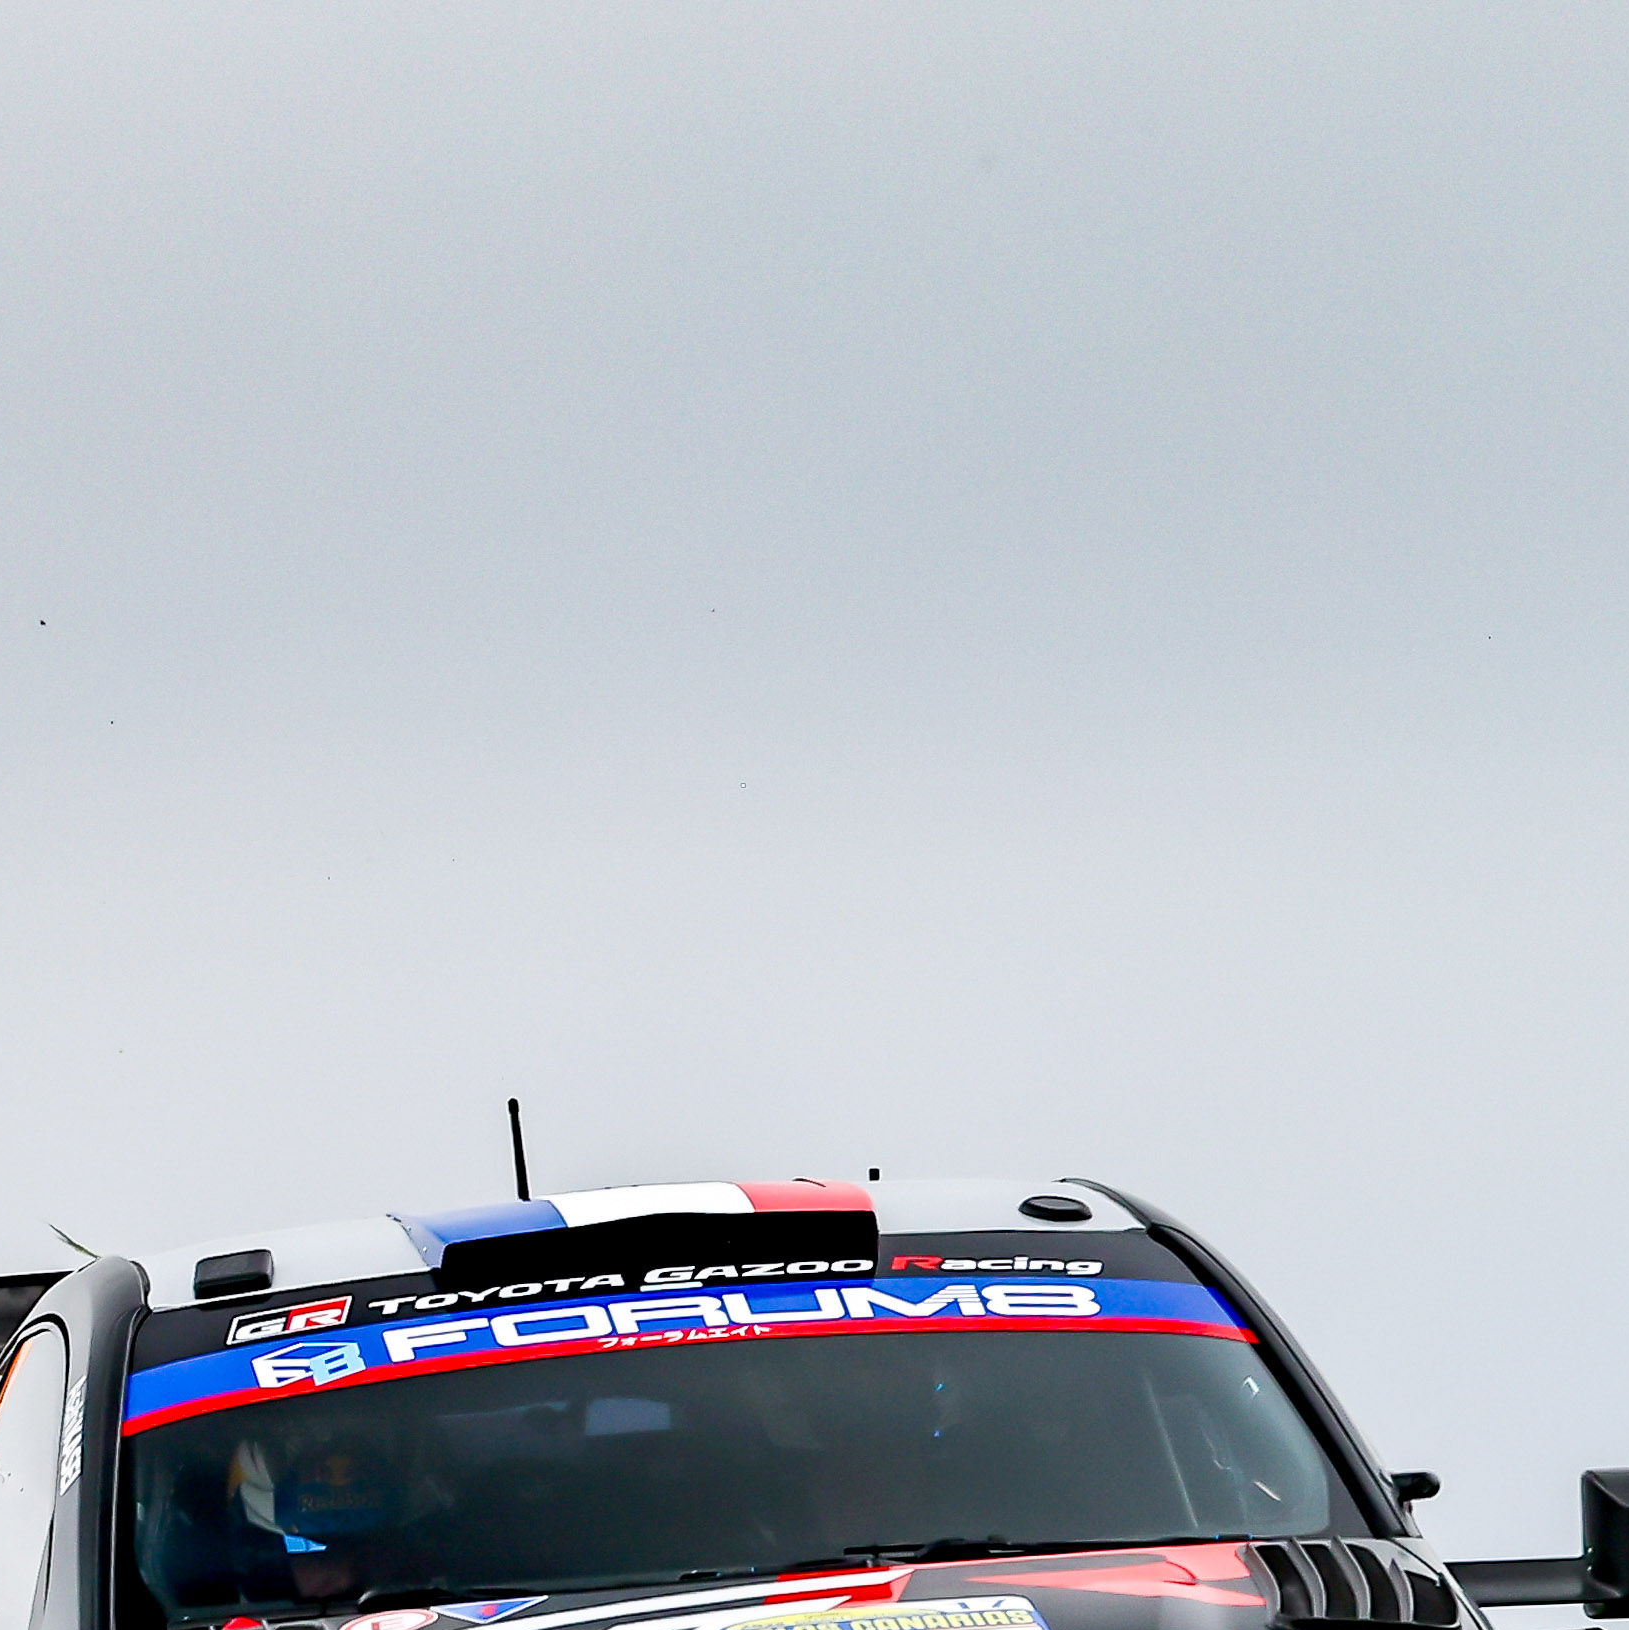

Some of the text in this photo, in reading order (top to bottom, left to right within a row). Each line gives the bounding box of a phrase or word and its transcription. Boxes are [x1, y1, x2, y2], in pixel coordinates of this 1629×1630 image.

[234, 1255, 1103, 1341] GR TOYOTA GAZOO Racing
[382, 1284, 1102, 1364] FORUM8
[597, 1323, 772, 1349] フォーラムエイト
